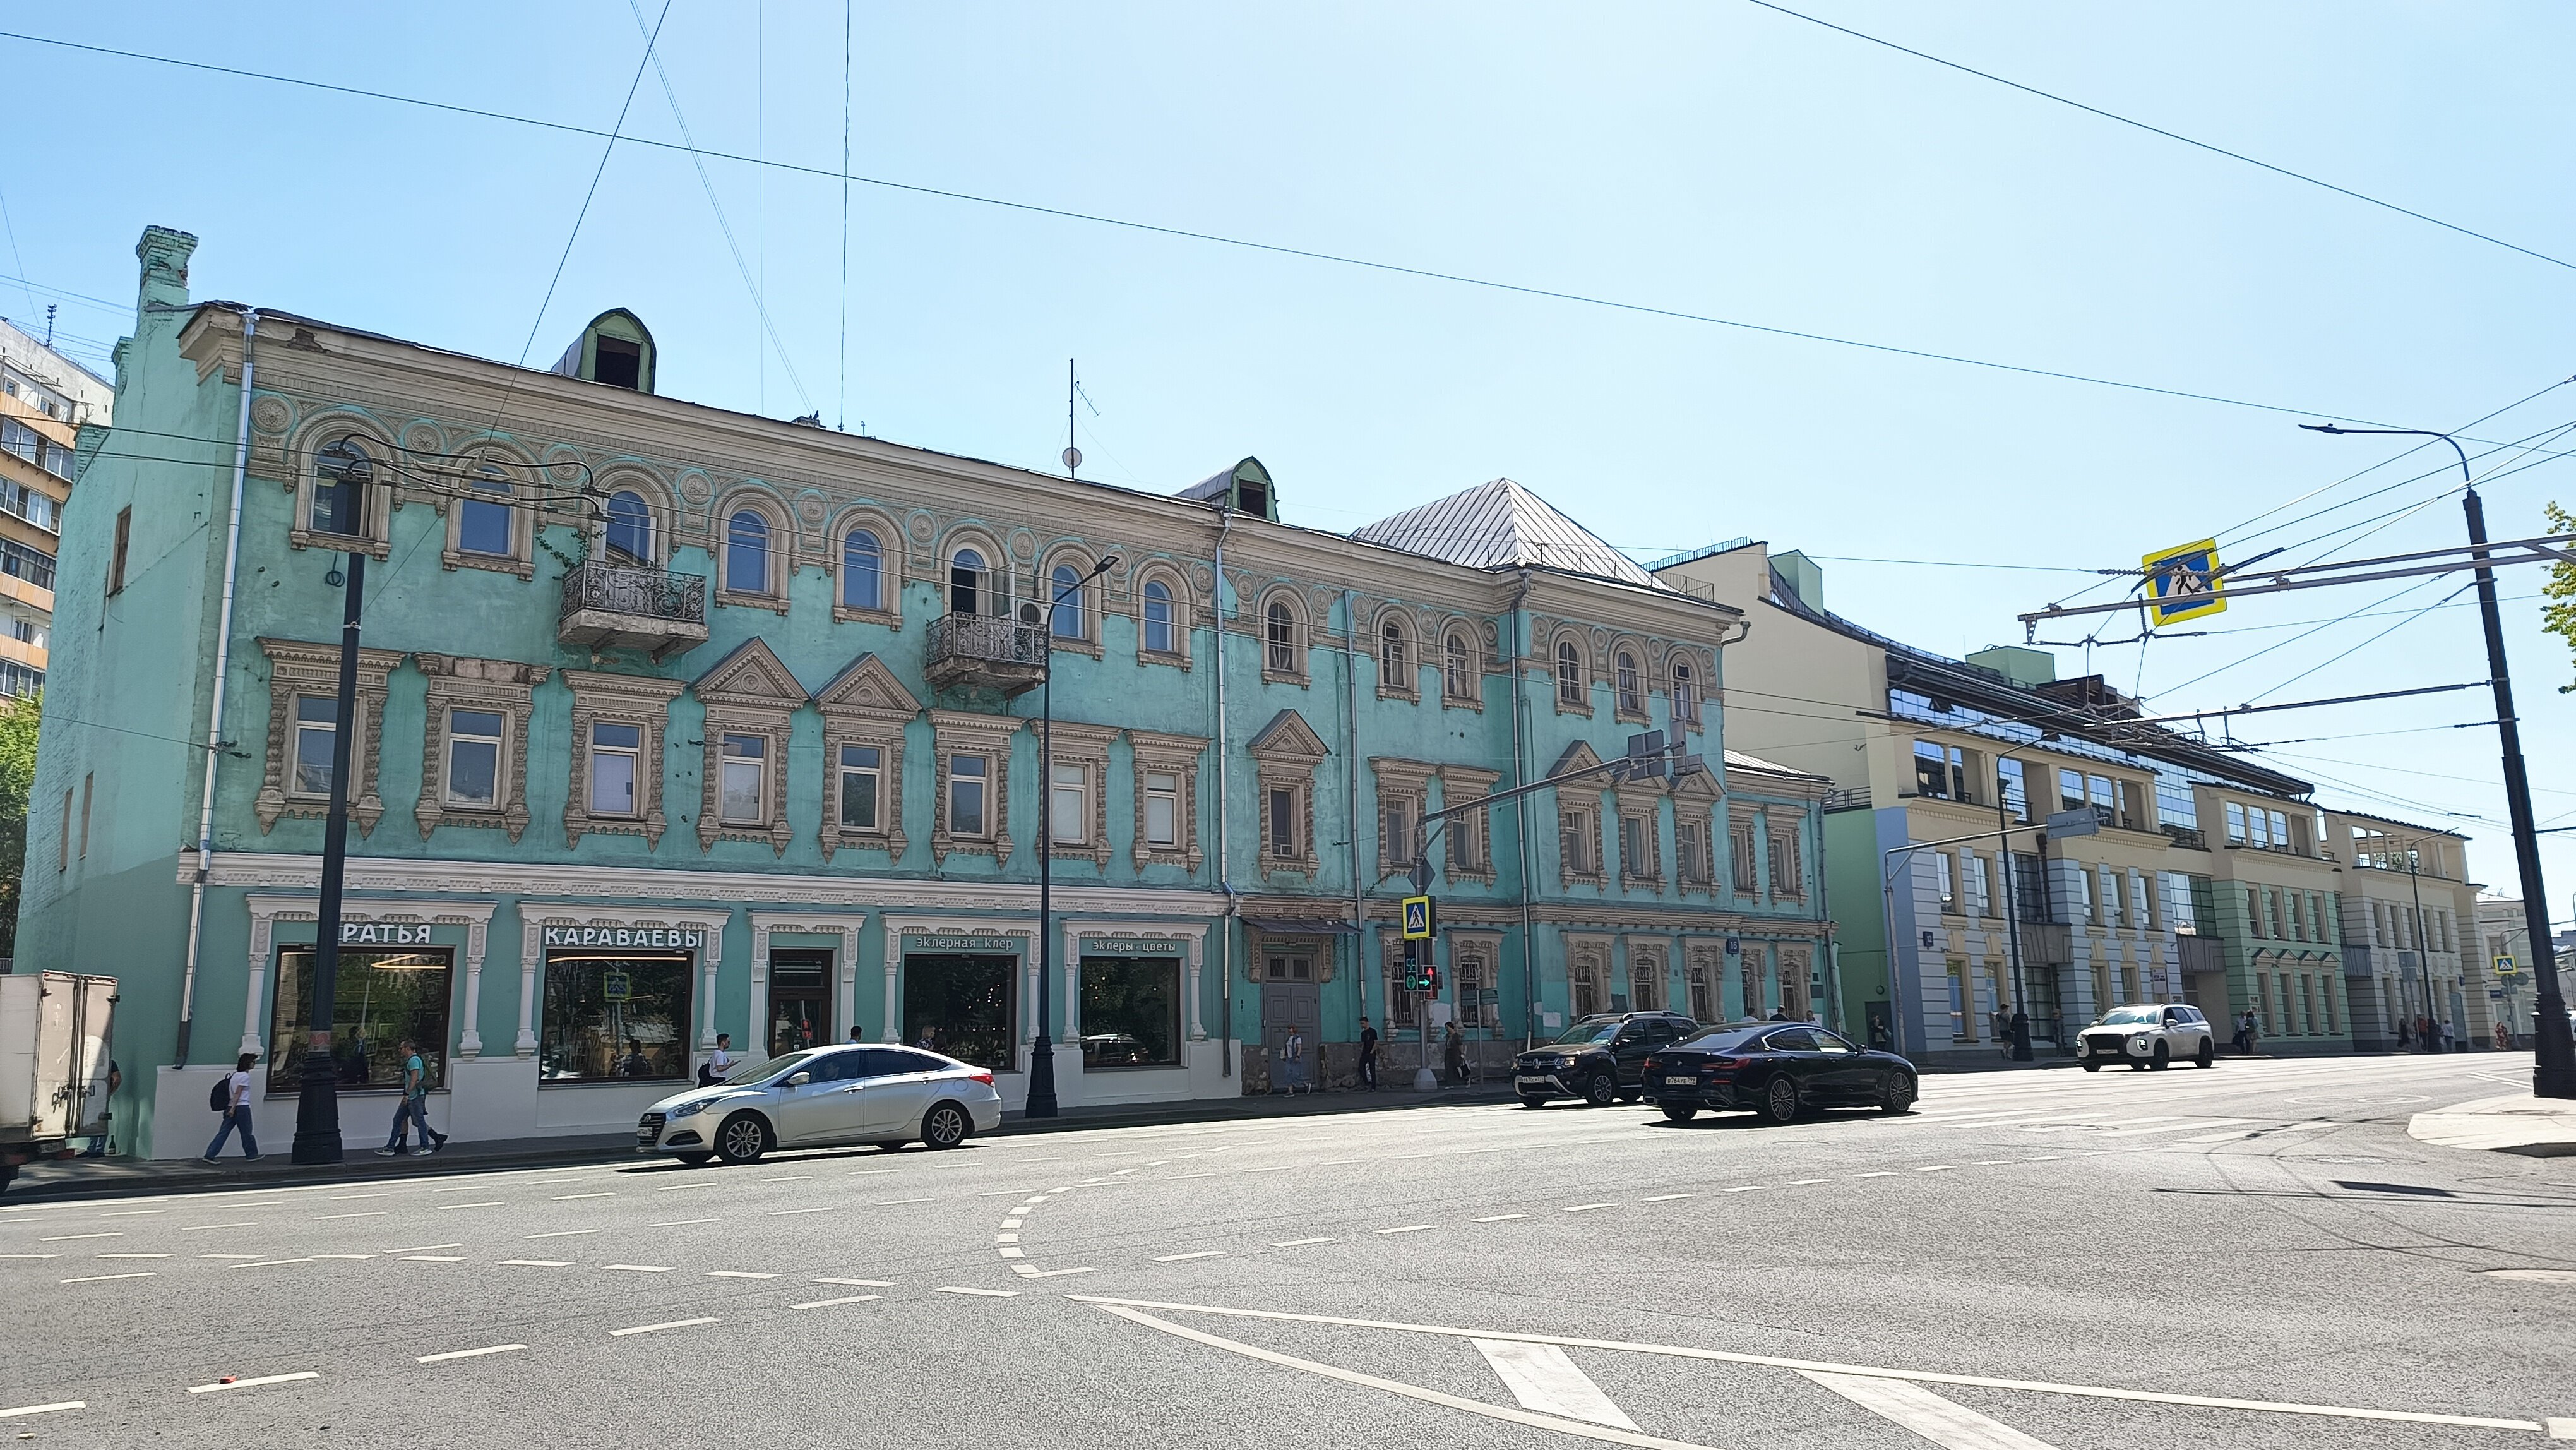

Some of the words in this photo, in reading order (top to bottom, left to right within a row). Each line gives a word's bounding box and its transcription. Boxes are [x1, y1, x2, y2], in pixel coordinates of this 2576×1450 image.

[342, 923, 431, 944] РАТЬЯ
[545, 927, 703, 947] КАРАВАЕВЫ
[916, 937, 975, 950] эклерная
[984, 938, 1013, 951] клер
[1092, 940, 1133, 953] эклеры
[1142, 944, 1176, 952] цветы
[1731, 941, 1738, 950] 16
